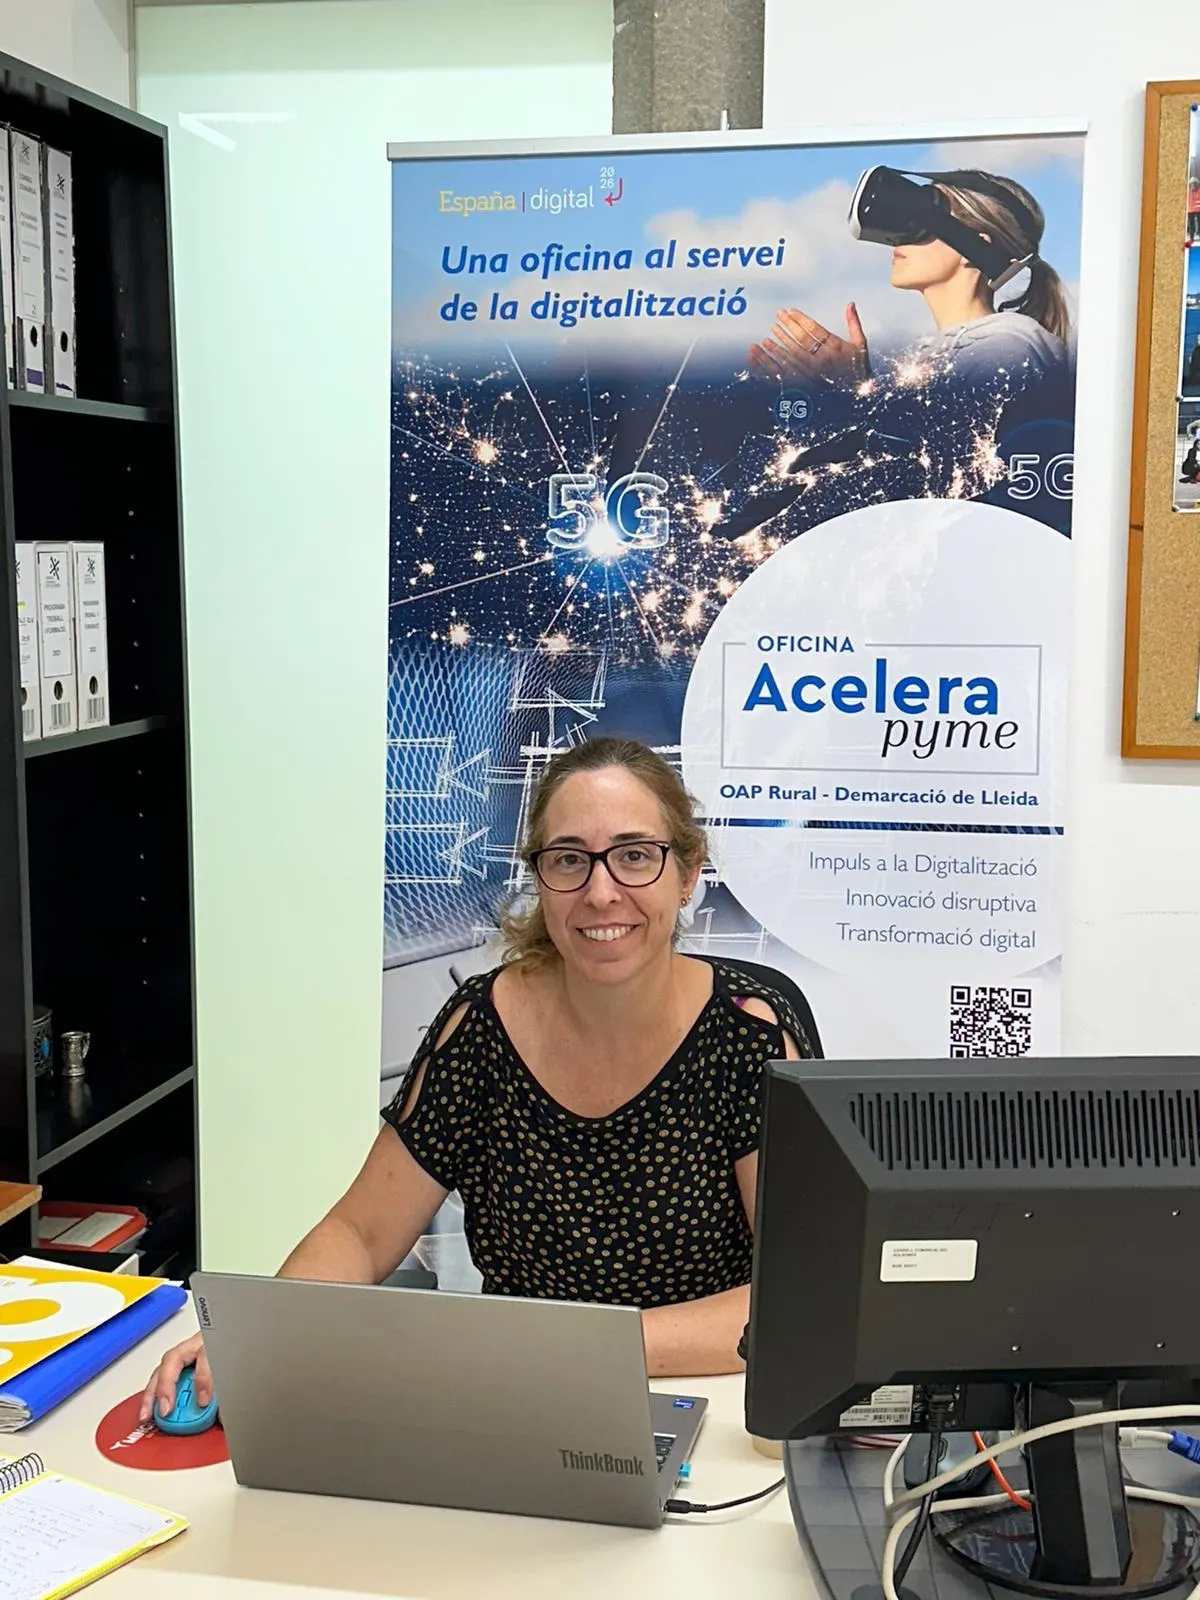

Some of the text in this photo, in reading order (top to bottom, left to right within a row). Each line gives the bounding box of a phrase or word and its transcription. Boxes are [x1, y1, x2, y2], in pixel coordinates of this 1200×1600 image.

[600, 166, 615, 178] 20
[439, 185, 595, 217] España digital
[441, 238, 787, 279] Una oficina al servei
[440, 286, 748, 329] de la digitalització
[778, 400, 808, 419] 5G
[1007, 453, 1074, 500] 5G
[545, 472, 670, 549] 5G
[757, 635, 855, 653] OFICINA
[742, 658, 999, 715] Acelera
[880, 717, 1019, 759] pyme
[719, 784, 763, 800] OAP
[768, 785, 817, 801] Rural
[835, 786, 947, 804] Demarcació
[952, 790, 975, 805] de
[980, 790, 1039, 807] Lleida
[808, 851, 1038, 879] Impuls a la Digitalització
[845, 888, 1037, 916] Innovació disruptiva
[835, 922, 1036, 953] Transformació digital
[200, 1297, 212, 1327] Lenovo
[558, 1449, 645, 1476] ThinkBook
